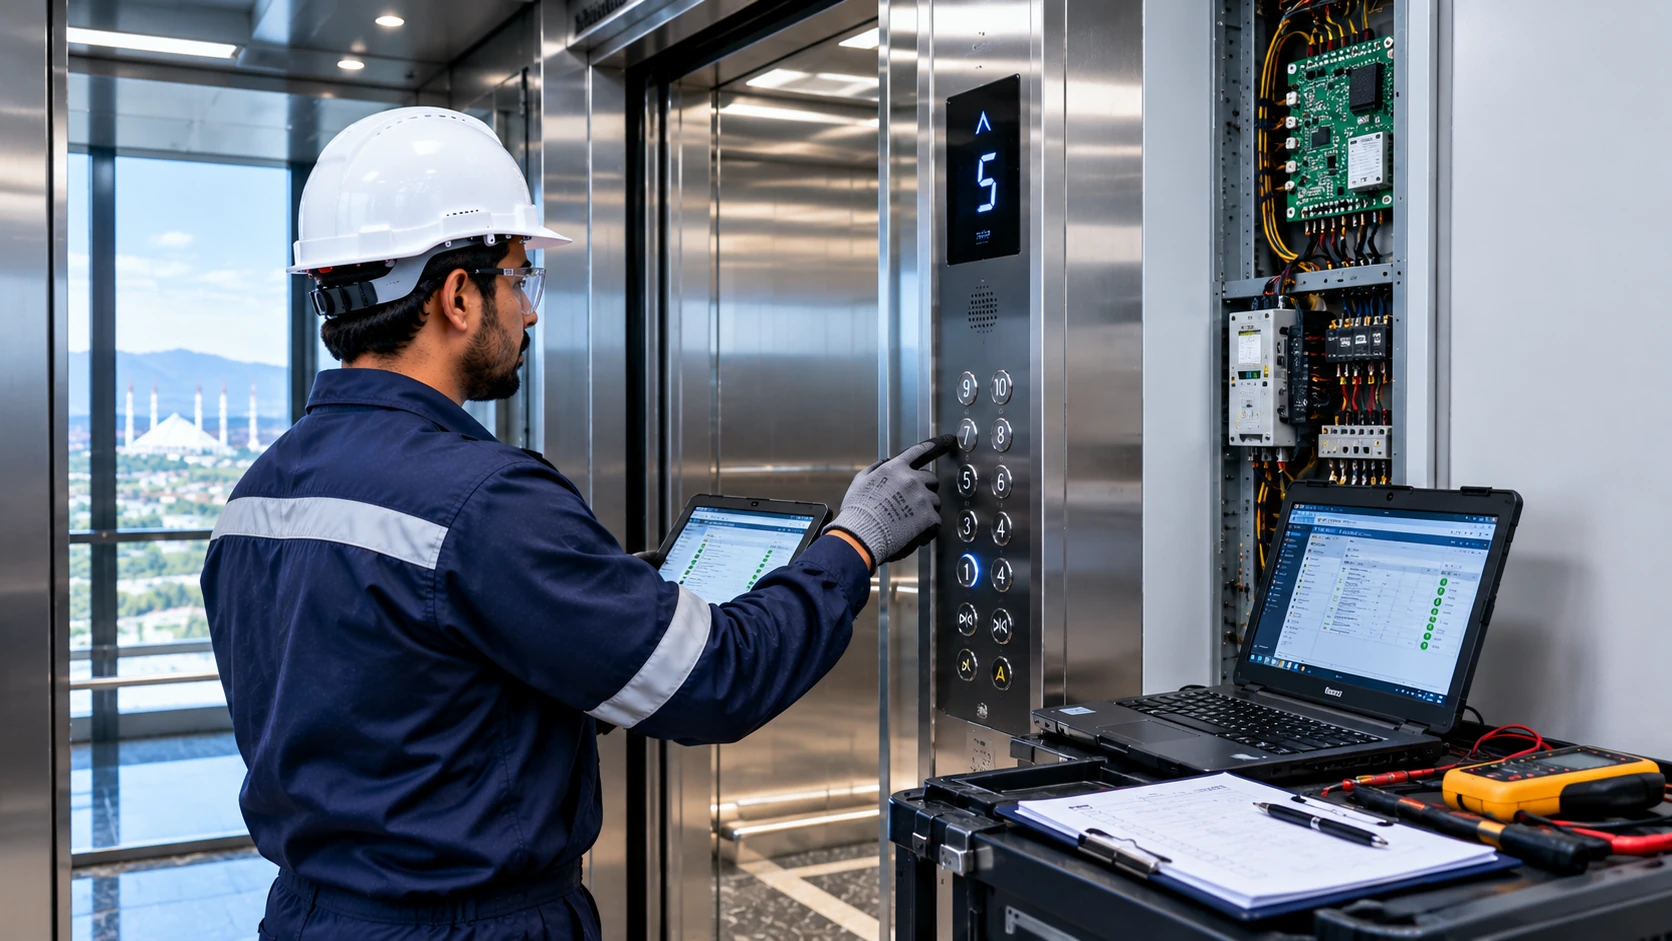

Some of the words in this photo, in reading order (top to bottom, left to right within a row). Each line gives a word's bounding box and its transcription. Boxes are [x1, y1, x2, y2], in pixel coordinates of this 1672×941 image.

[977, 152, 997, 213] 5
[963, 379, 970, 397] 9
[994, 378, 1007, 396] 10
[963, 426, 970, 445] 7
[997, 425, 1005, 444] 8
[963, 471, 971, 489] 5
[997, 473, 1005, 491] 6
[963, 517, 971, 535] 3
[997, 519, 1005, 538] 4
[964, 563, 969, 581] 1
[996, 566, 1005, 584] 4
